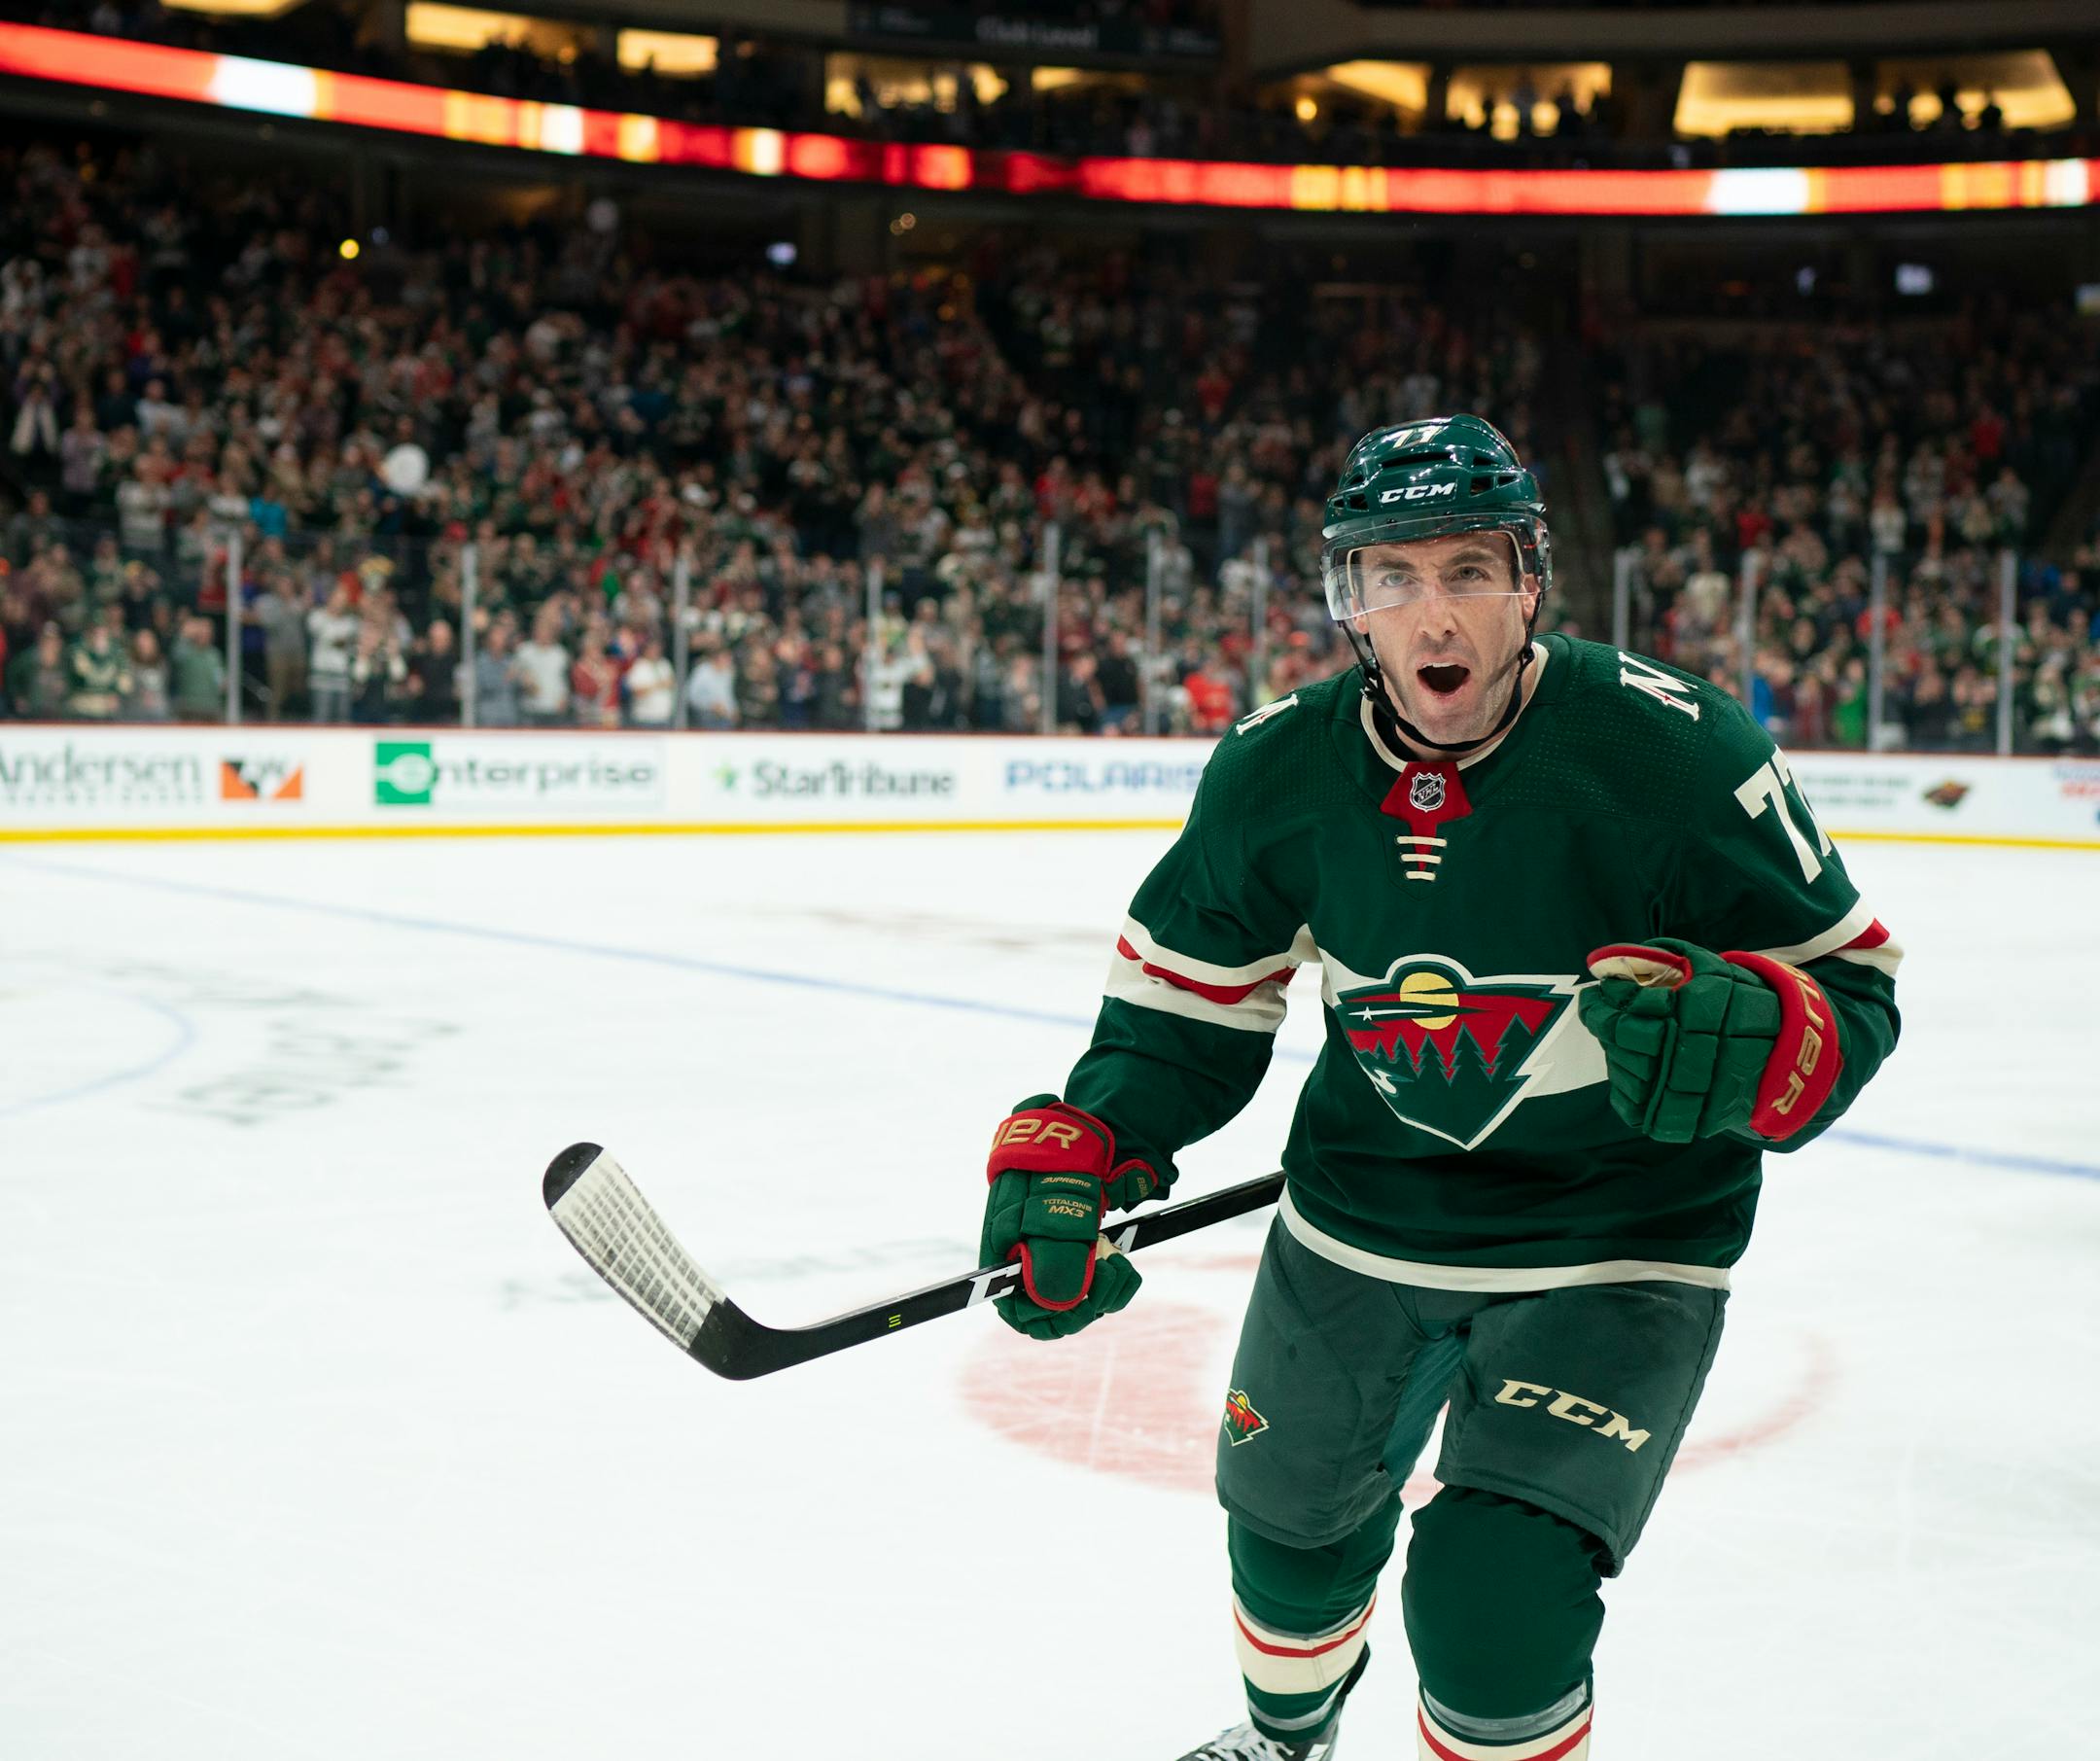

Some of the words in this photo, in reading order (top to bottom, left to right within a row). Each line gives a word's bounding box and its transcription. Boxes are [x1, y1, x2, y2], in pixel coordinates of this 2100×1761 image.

[1382, 482, 1455, 504] CCM
[1004, 758, 1205, 792] POLARIS
[1417, 783, 1439, 803] NHL
[1048, 1205, 1085, 1218] MX3
[1494, 1379, 1652, 1453] CCM
